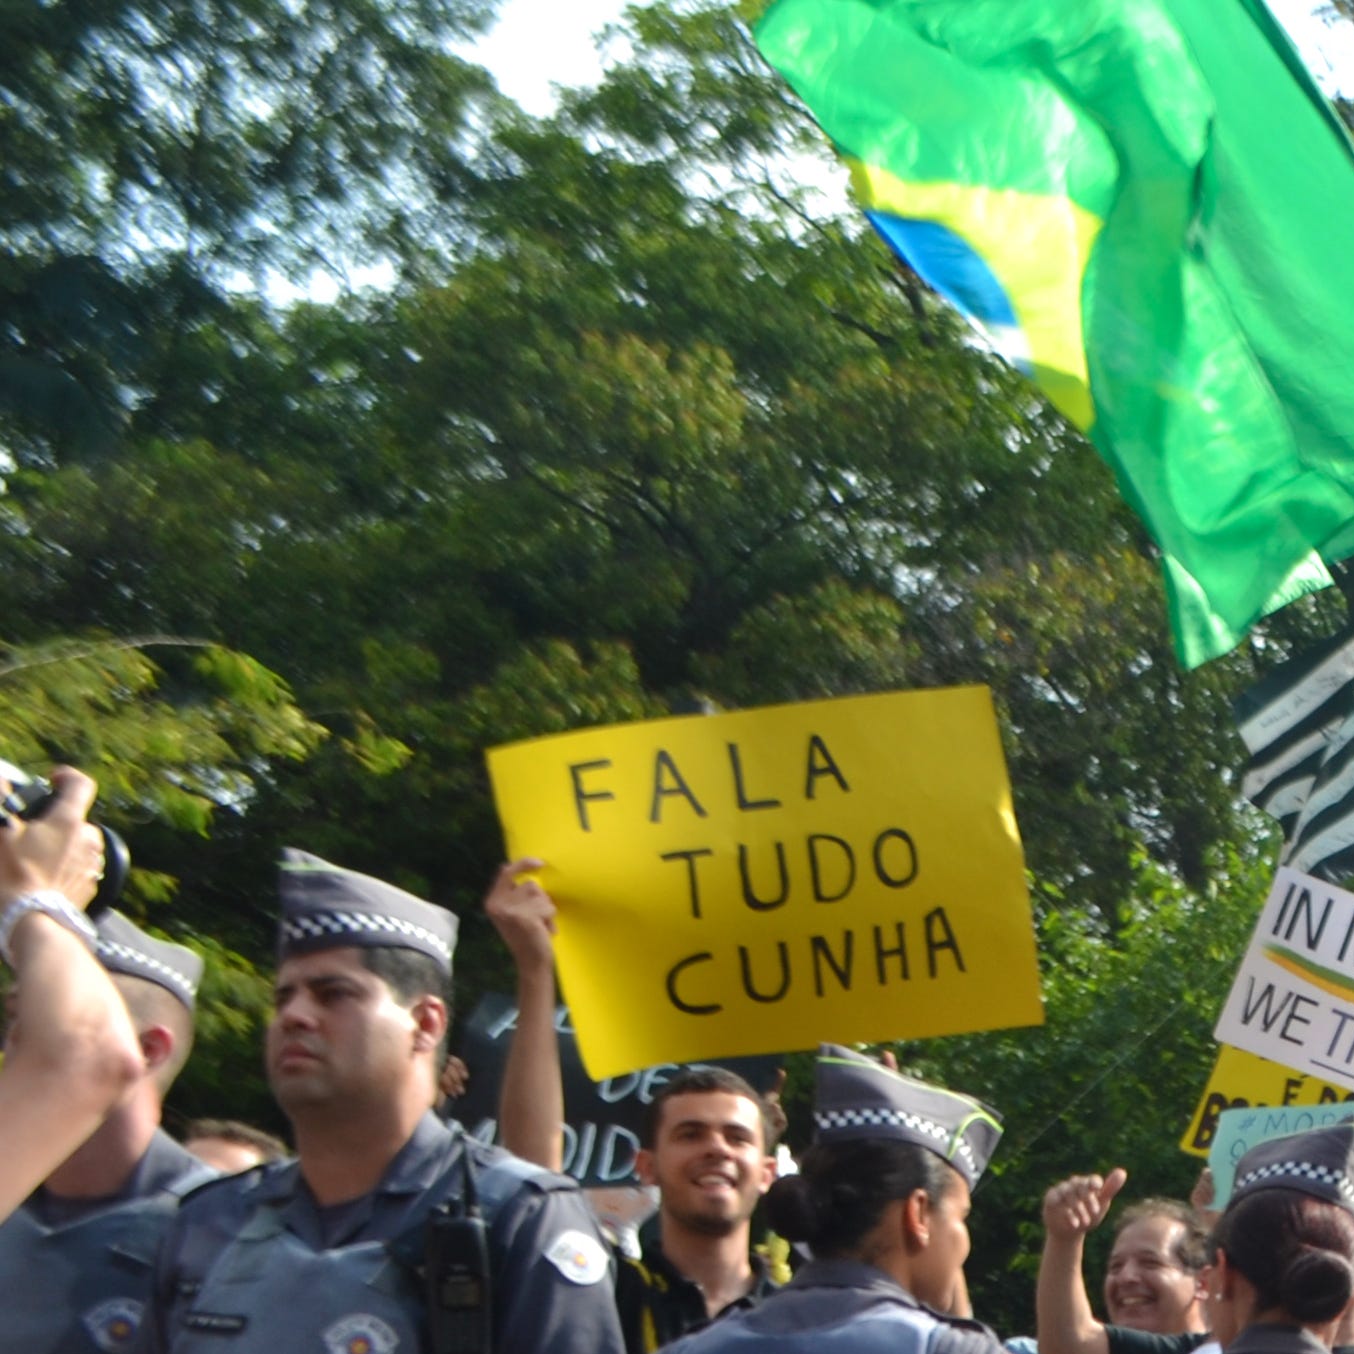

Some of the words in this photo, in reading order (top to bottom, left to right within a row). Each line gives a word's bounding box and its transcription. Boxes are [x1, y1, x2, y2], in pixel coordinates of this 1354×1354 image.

[569, 733, 851, 832] FALA
[661, 828, 918, 919] TUDO
[1272, 882, 1333, 951] IN
[665, 905, 967, 1016] CUNHA
[1240, 975, 1317, 1047] WE
